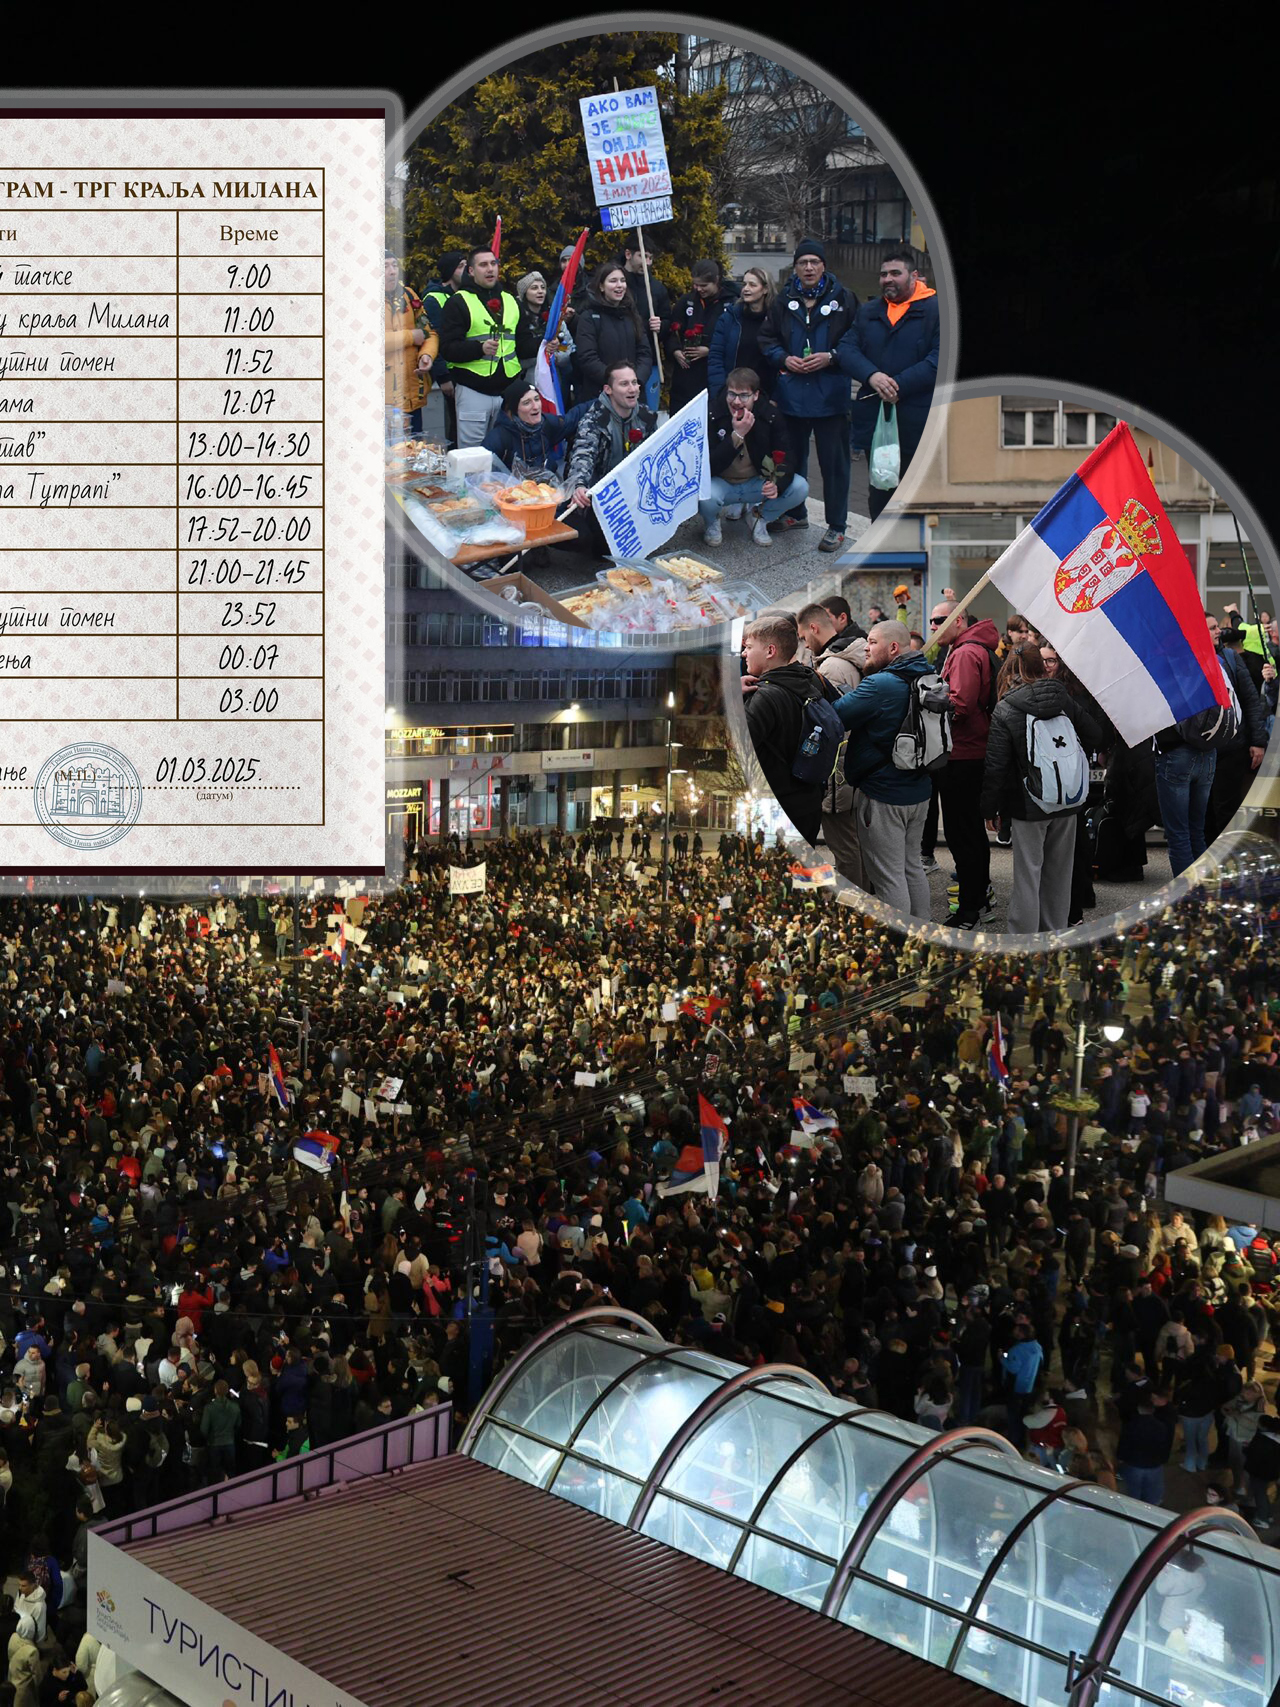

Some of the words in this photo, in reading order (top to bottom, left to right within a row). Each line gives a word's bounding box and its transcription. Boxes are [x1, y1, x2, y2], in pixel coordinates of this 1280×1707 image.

[588, 98, 619, 117] АКО
[625, 91, 653, 108] ВАМ
[591, 119, 612, 136] ЈЕ
[602, 131, 648, 154] ОНДА
[391, 728, 426, 738] MOZZART
[387, 787, 422, 798] MOZZART
